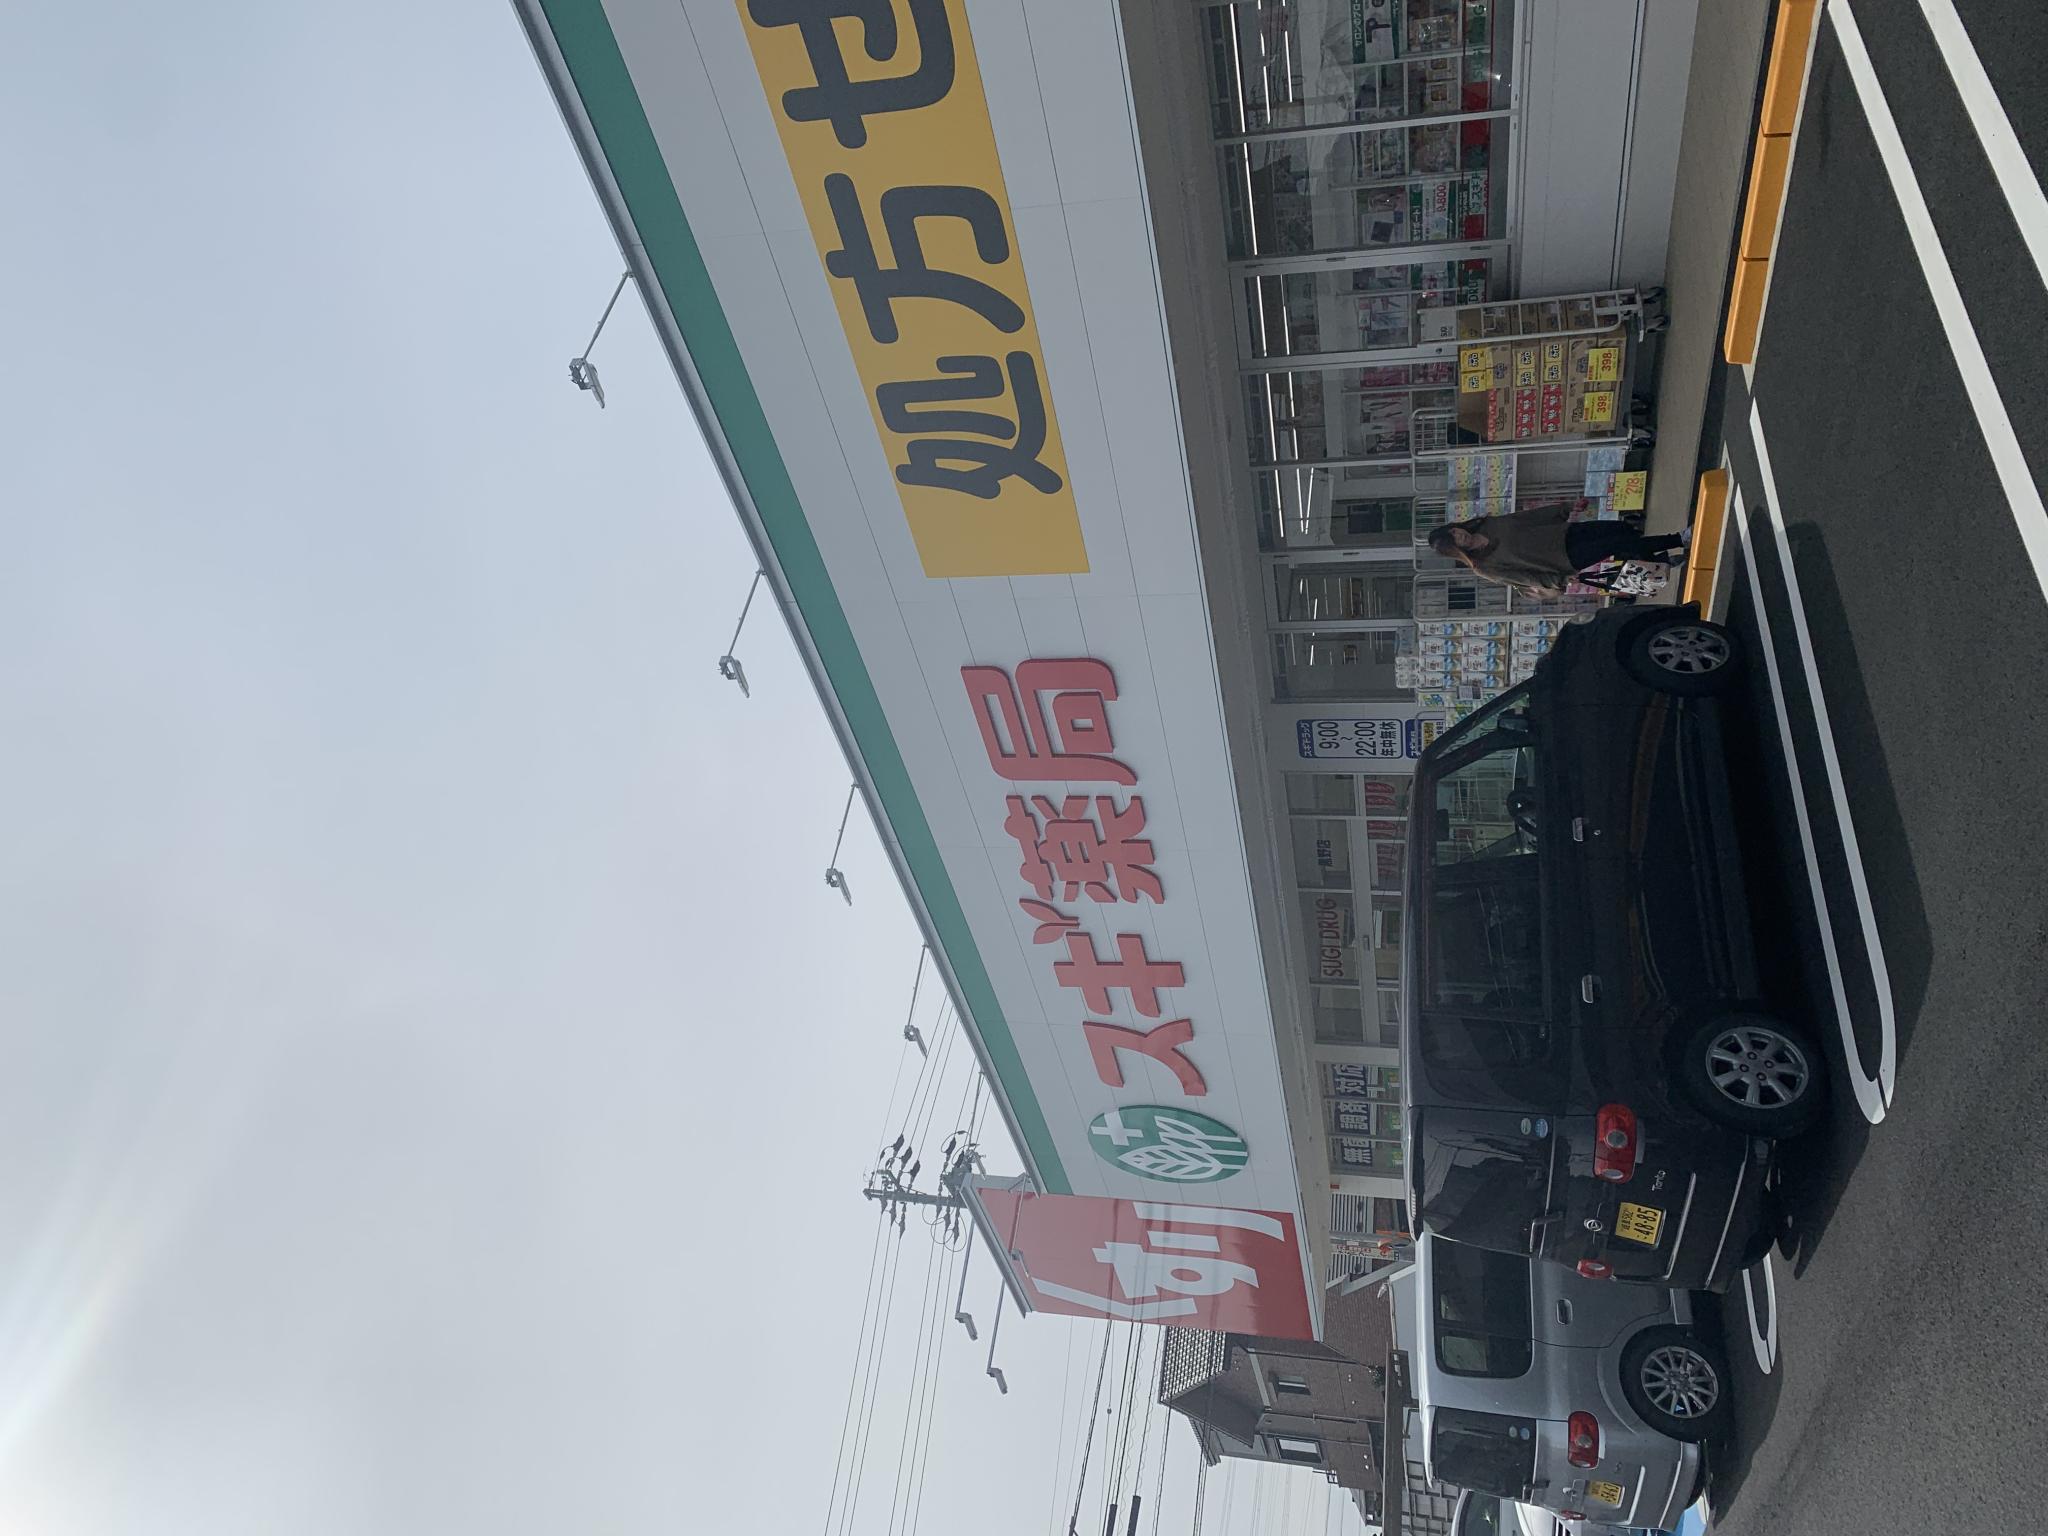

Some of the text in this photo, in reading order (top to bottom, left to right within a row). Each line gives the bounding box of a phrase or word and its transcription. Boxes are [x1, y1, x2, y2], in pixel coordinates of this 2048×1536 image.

[1602, 352, 1612, 372] 398
[1596, 396, 1608, 413] 398
[1625, 478, 1640, 494] 218
[1301, 722, 1312, 756] スギドラッグ
[1317, 721, 1340, 749] 9:00
[1354, 721, 1376, 756] 22:00
[1380, 722, 1396, 756] 年中無休
[961, 658, 1207, 1096] スギ薬局
[1315, 898, 1344, 977] SUGI DRUG
[1033, 1203, 1285, 1324] くすり
